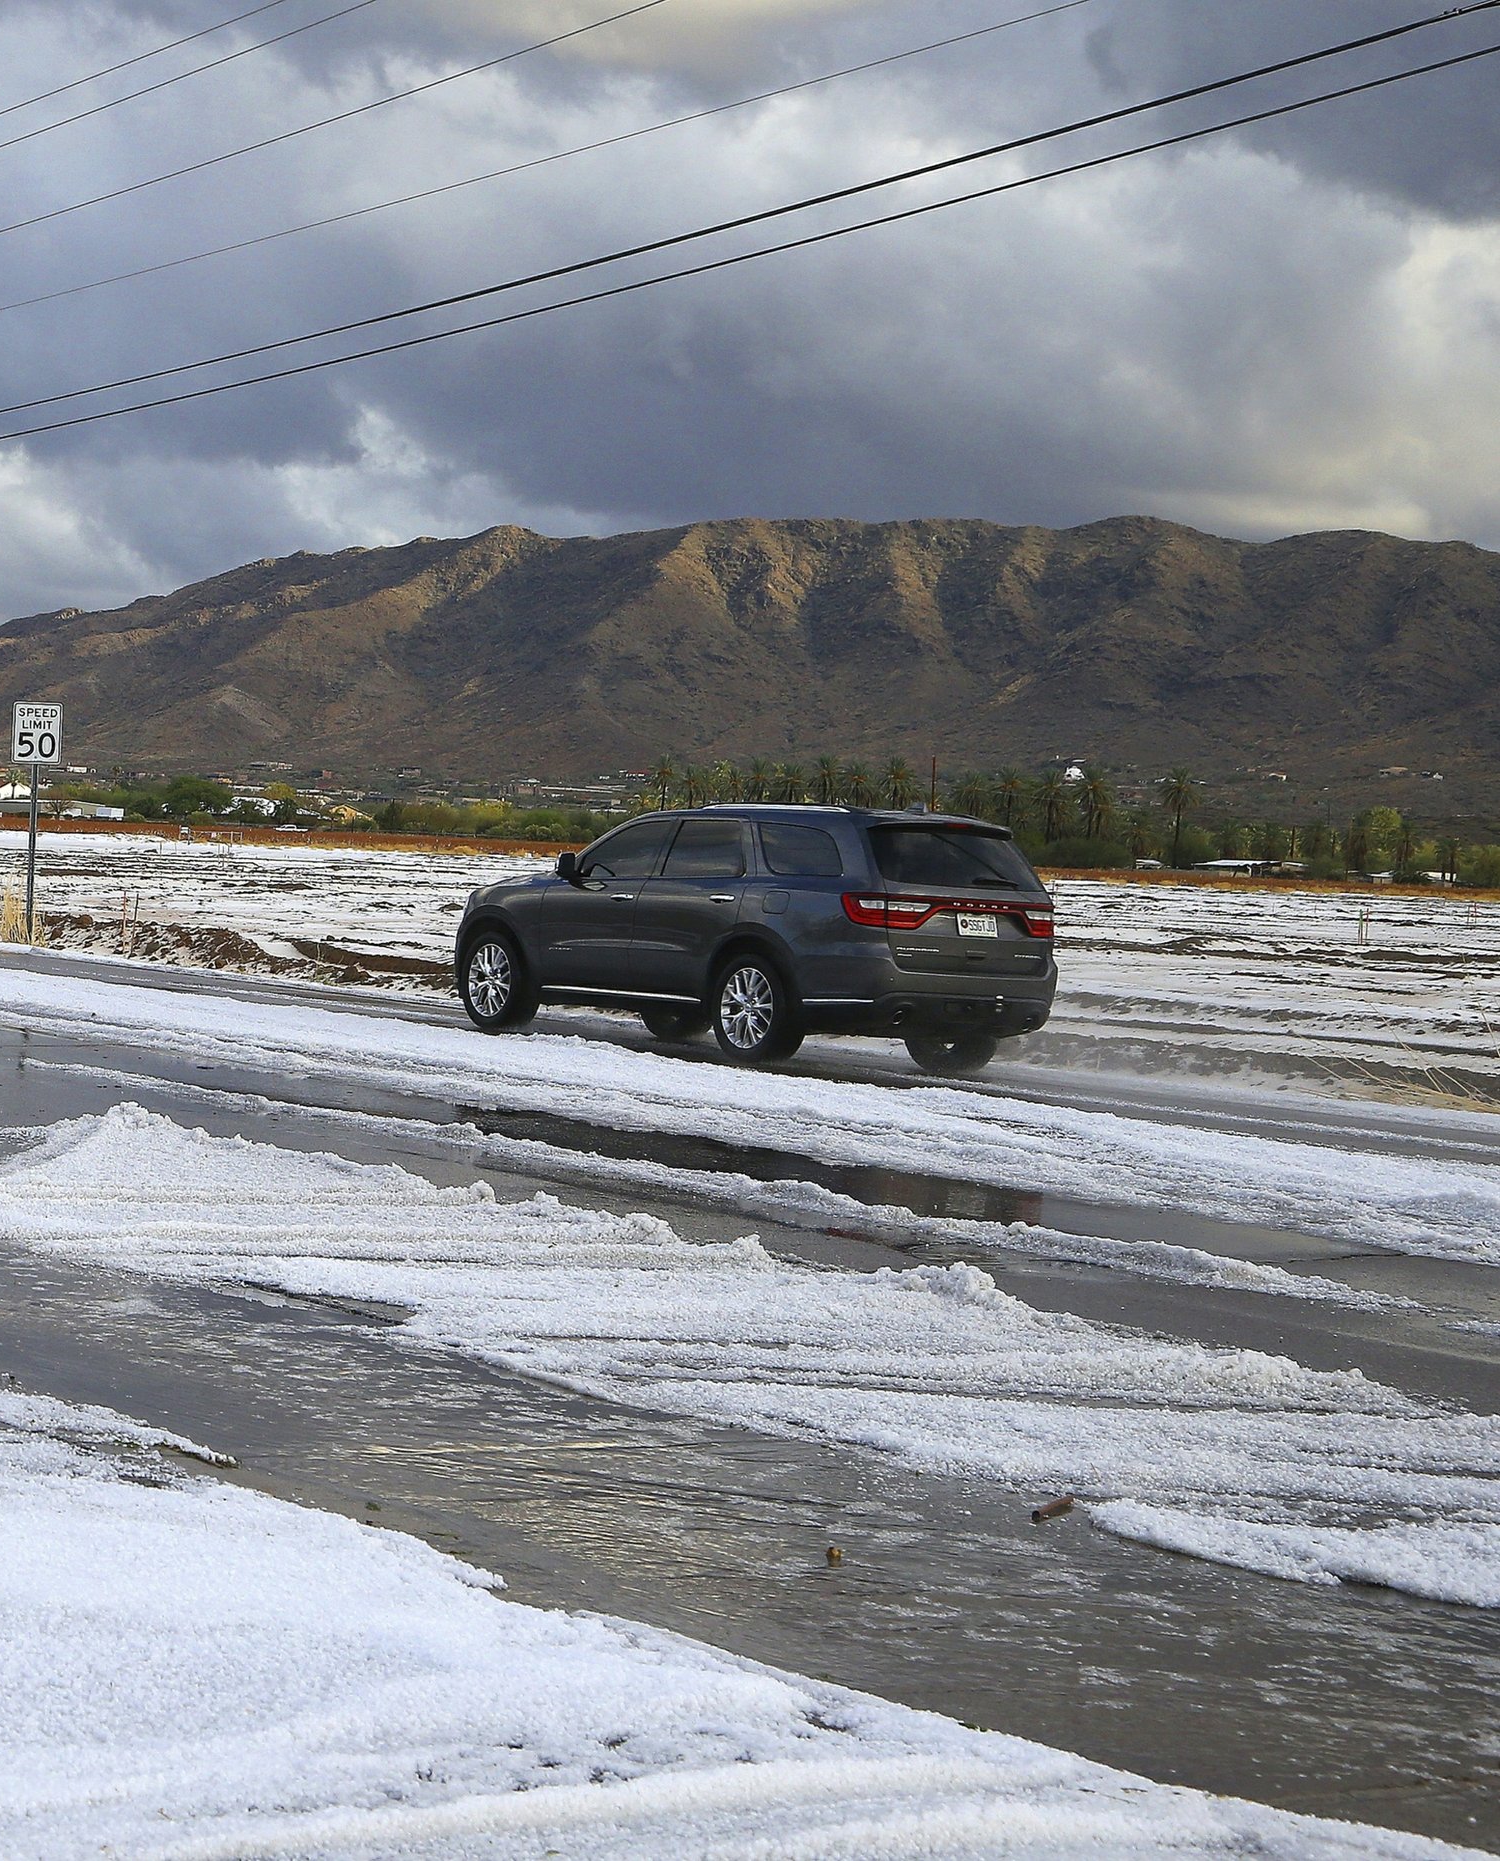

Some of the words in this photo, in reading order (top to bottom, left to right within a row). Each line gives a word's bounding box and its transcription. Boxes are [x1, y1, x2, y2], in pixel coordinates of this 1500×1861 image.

[18, 708, 58, 718] SPEED
[22, 720, 53, 729] LIMIT
[17, 732, 56, 758] 50
